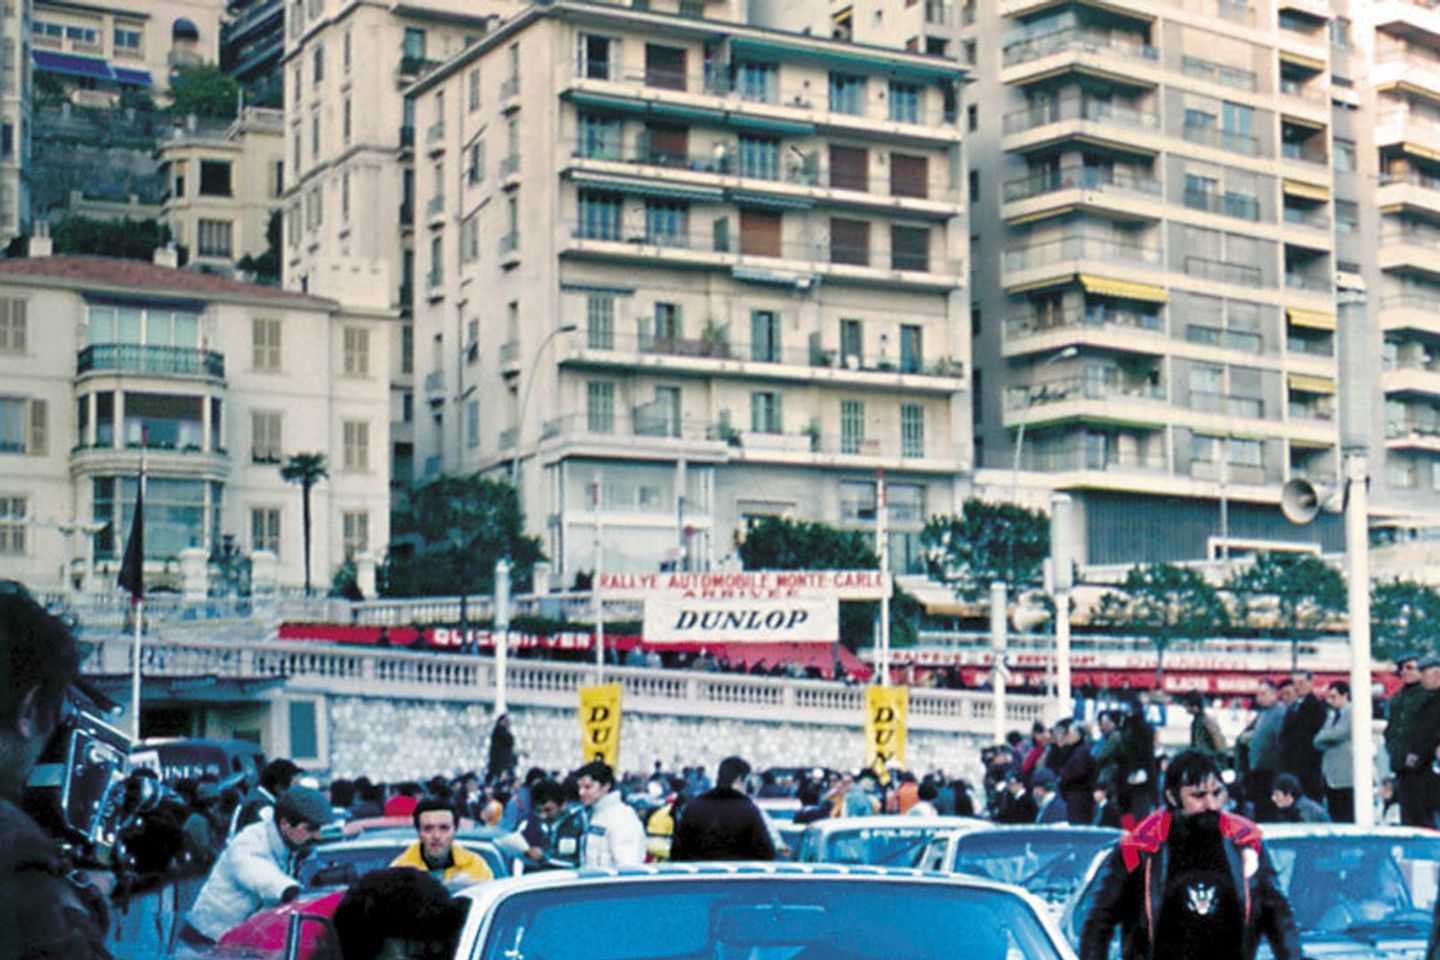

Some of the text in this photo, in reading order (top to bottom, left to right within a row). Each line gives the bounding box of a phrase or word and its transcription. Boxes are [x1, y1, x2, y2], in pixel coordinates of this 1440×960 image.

[600, 574, 657, 589] RALLYE
[667, 574, 767, 590] AUTOMOBILE
[674, 610, 809, 631] DUNLOP
